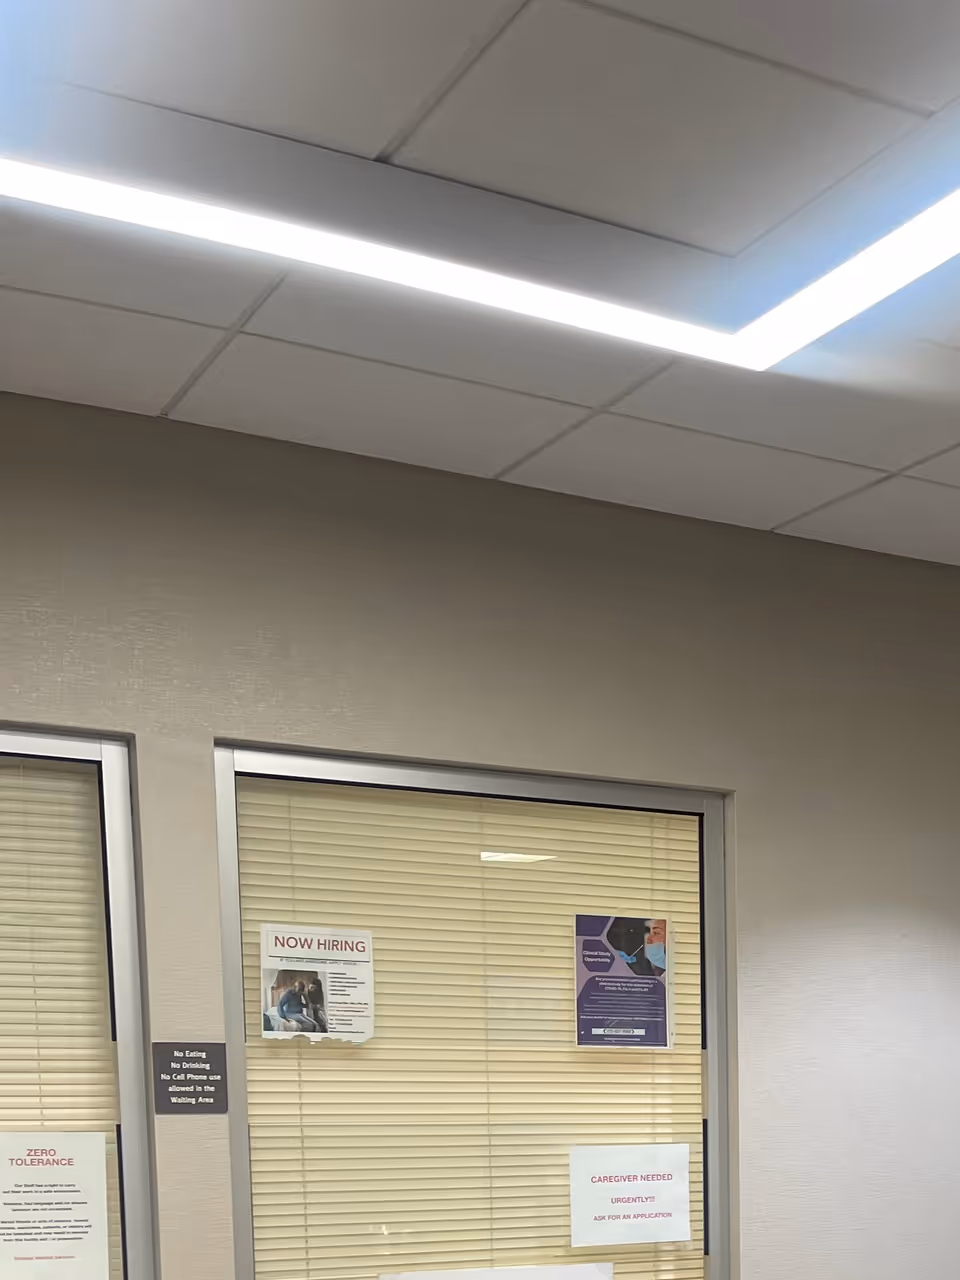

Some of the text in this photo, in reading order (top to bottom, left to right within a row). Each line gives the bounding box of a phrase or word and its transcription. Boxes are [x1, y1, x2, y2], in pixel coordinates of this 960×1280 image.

[274, 935, 366, 953] NOW HIRING
[185, 1050, 206, 1059] Eating
[182, 1062, 211, 1070] Drinking
[160, 1073, 171, 1081] No
[172, 1073, 185, 1081] Cell
[186, 1073, 207, 1081] Phone
[170, 1096, 214, 1105] Waiting Area
[26, 1148, 56, 1157] ZERO
[8, 1158, 75, 1167] TOLERANCE
[590, 1173, 673, 1184] CAREGIVER NEEDED
[610, 1196, 655, 1205] URGENTLY!!!
[632, 1212, 672, 1220] APPLICATION
